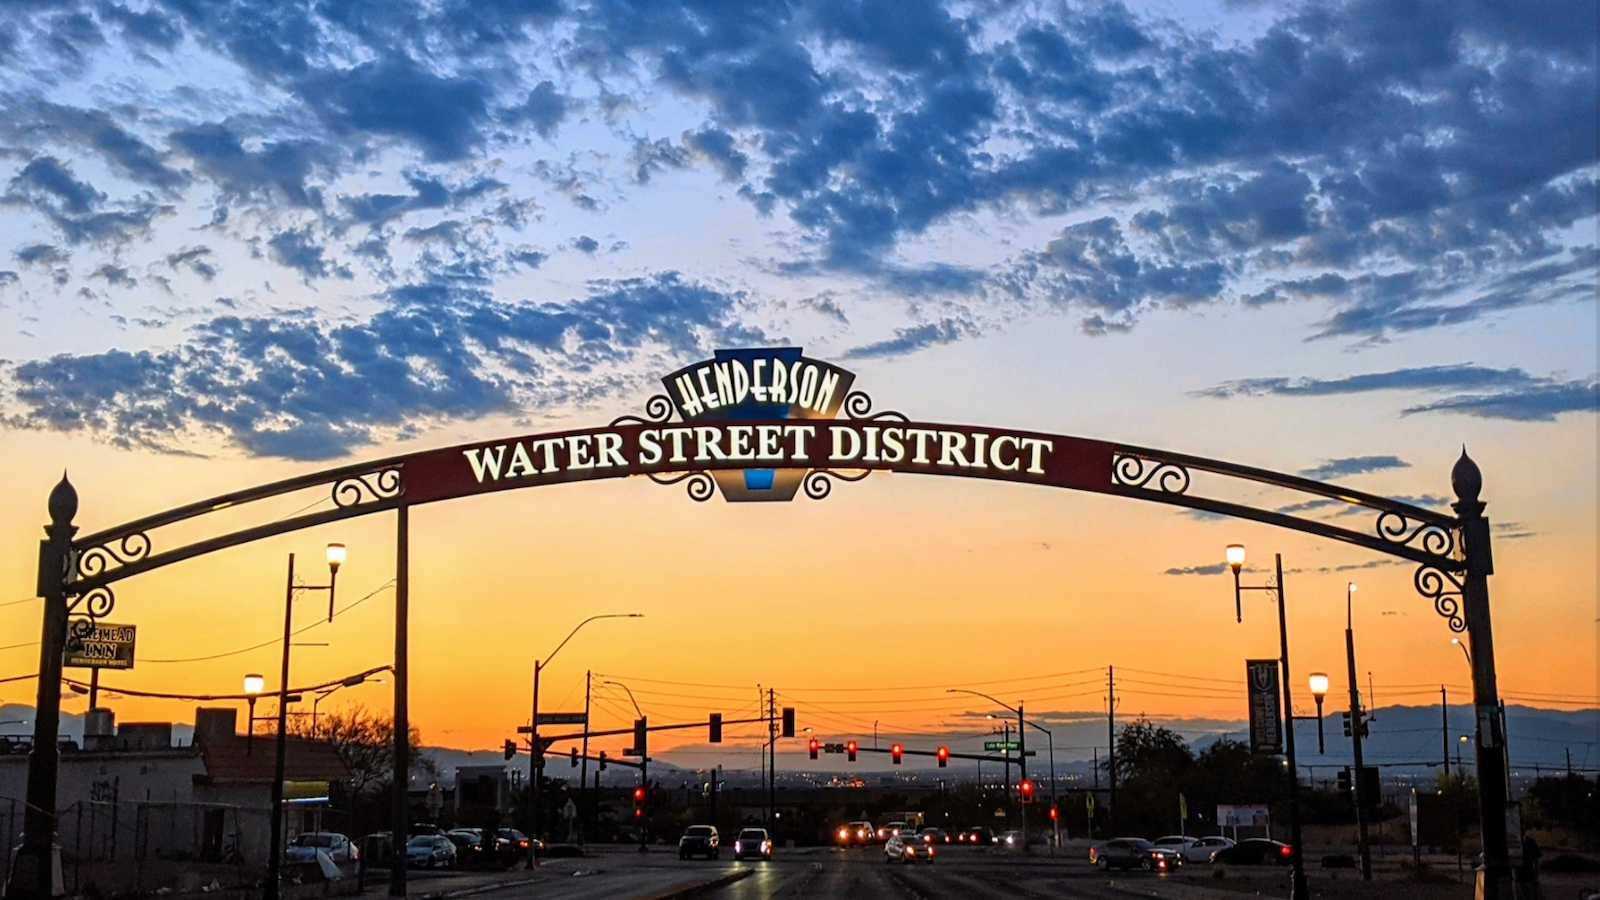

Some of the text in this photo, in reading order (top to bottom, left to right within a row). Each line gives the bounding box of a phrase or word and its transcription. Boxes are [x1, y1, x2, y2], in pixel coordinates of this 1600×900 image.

[675, 358, 839, 417] HENDERSON
[463, 425, 1053, 483] WATER STREET DISTRICT
[83, 641, 117, 659] INN
[101, 627, 134, 643] MEAD
